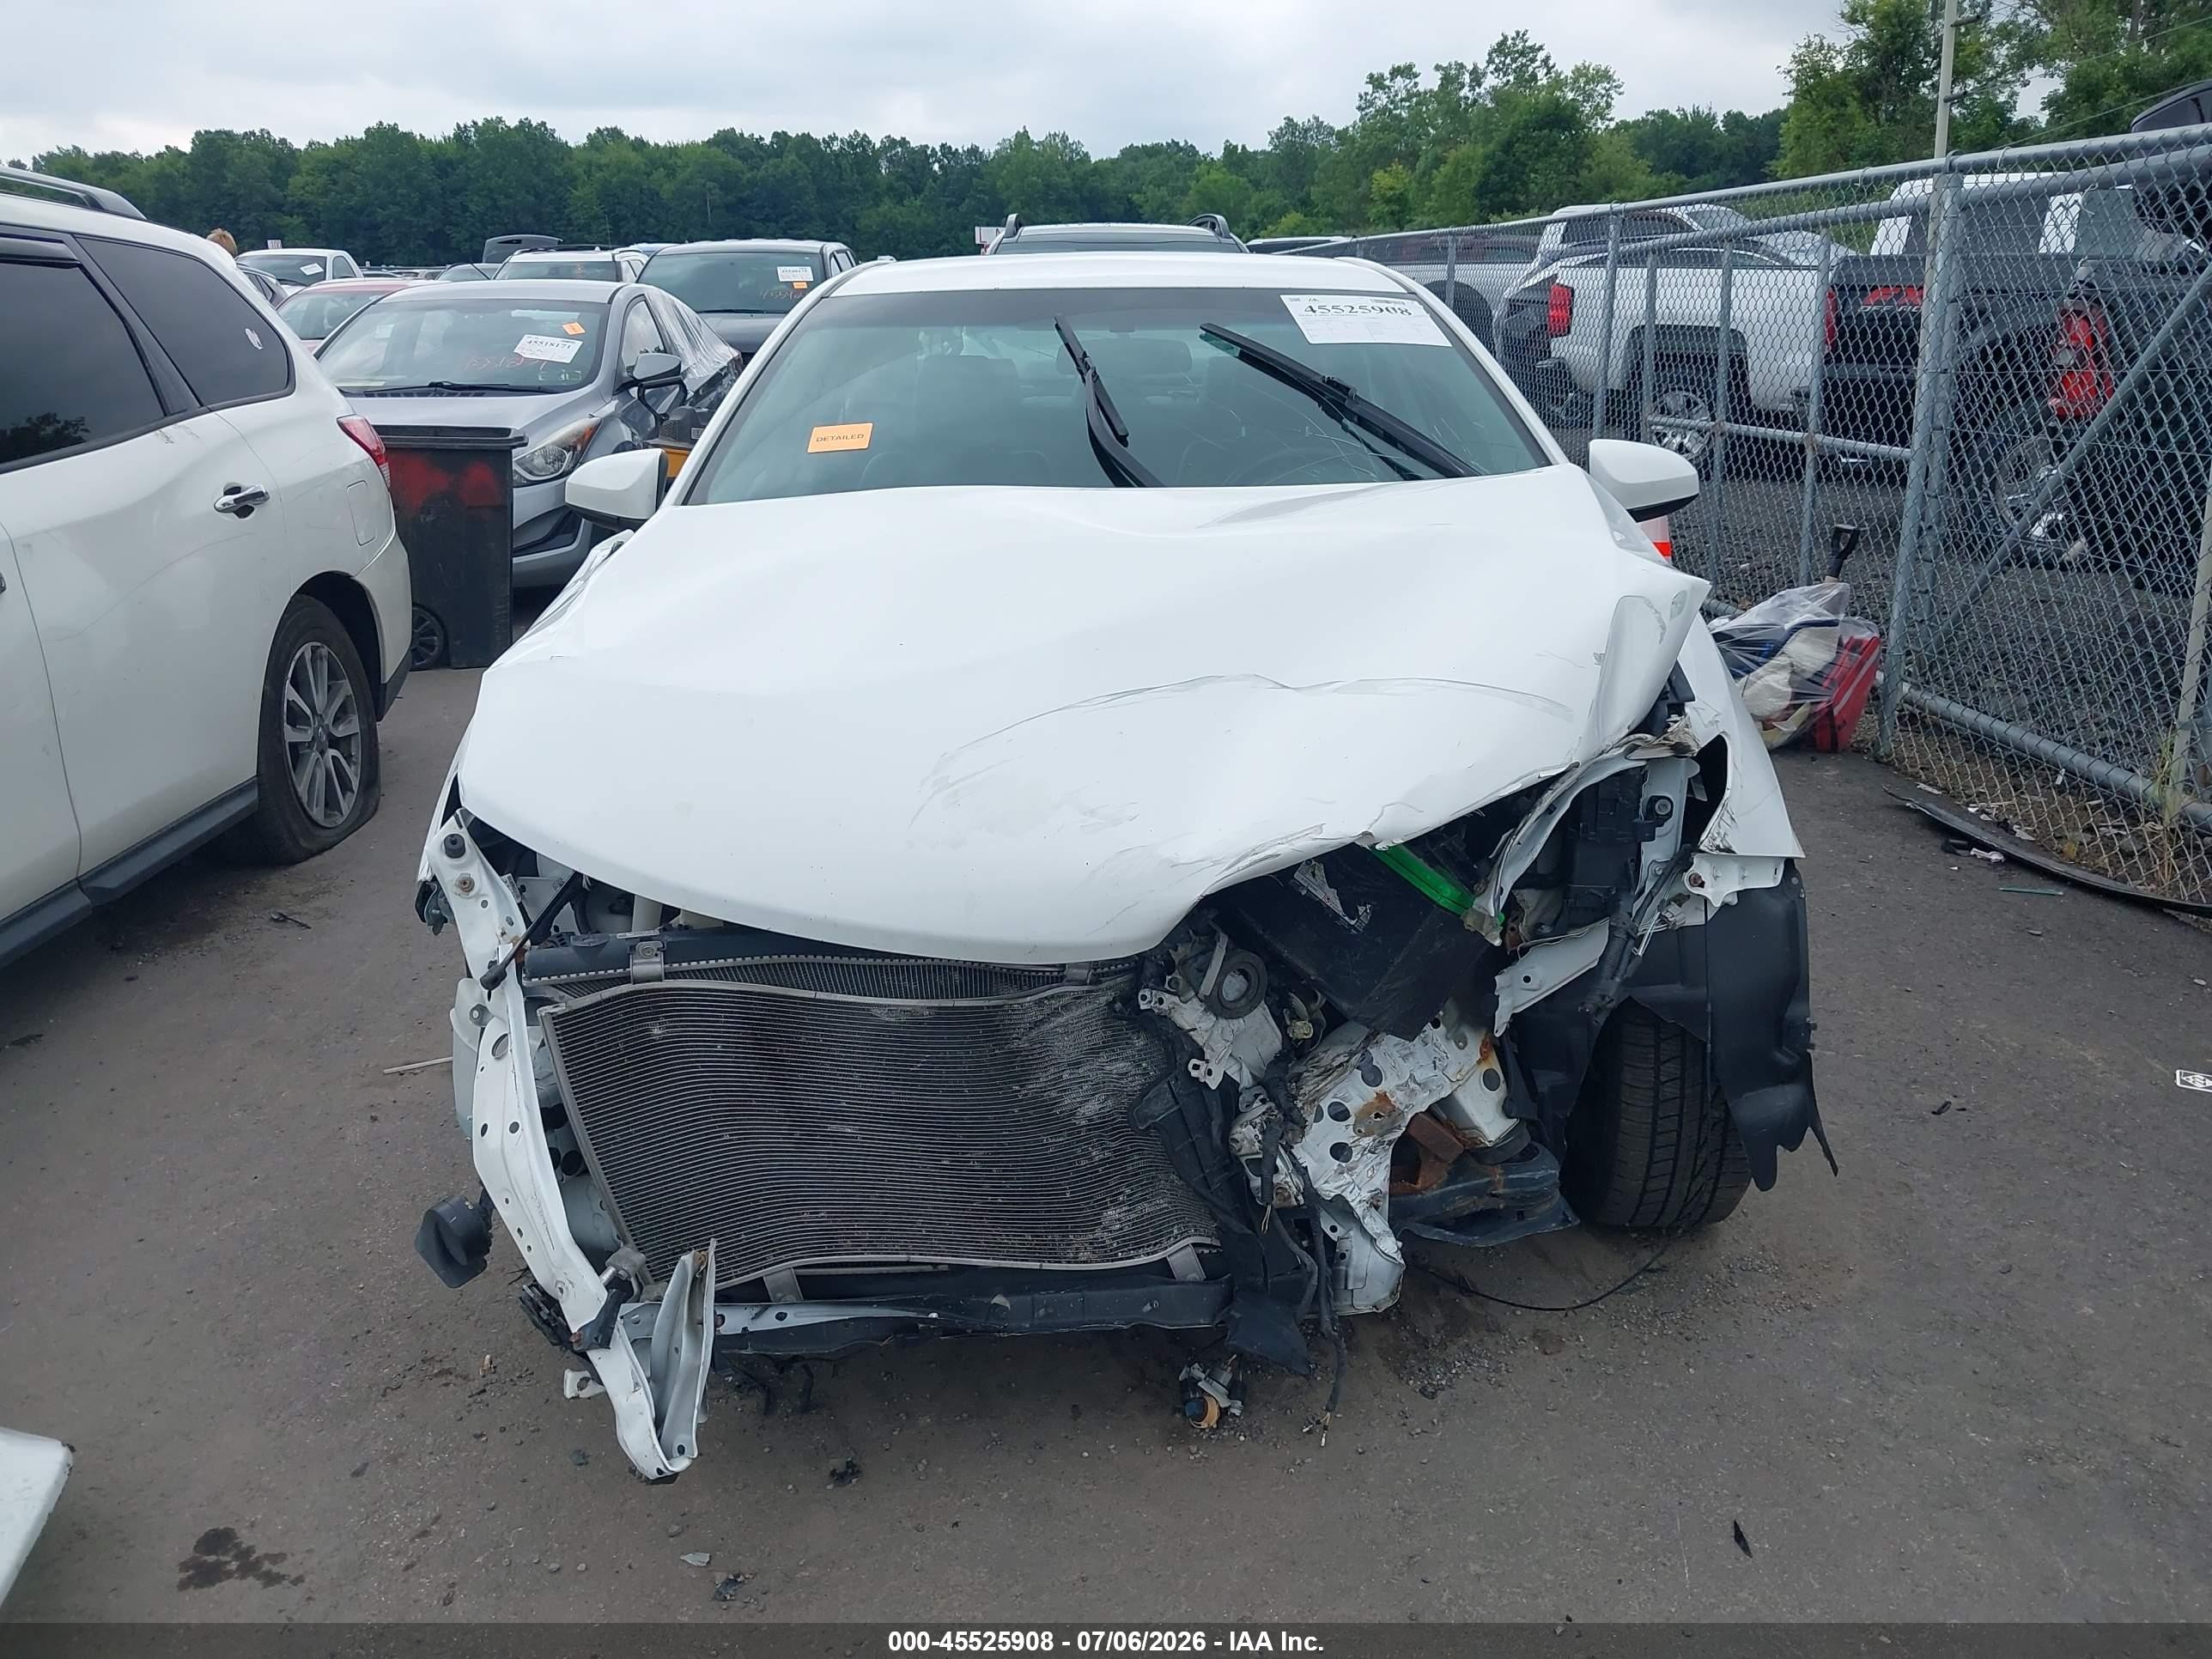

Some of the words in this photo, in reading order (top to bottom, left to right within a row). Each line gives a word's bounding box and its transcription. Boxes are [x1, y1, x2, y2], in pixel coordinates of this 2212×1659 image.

[1862, 287, 1923, 306] FX
[1304, 305, 1413, 316] 45525908
[816, 433, 865, 442] DETAILED
